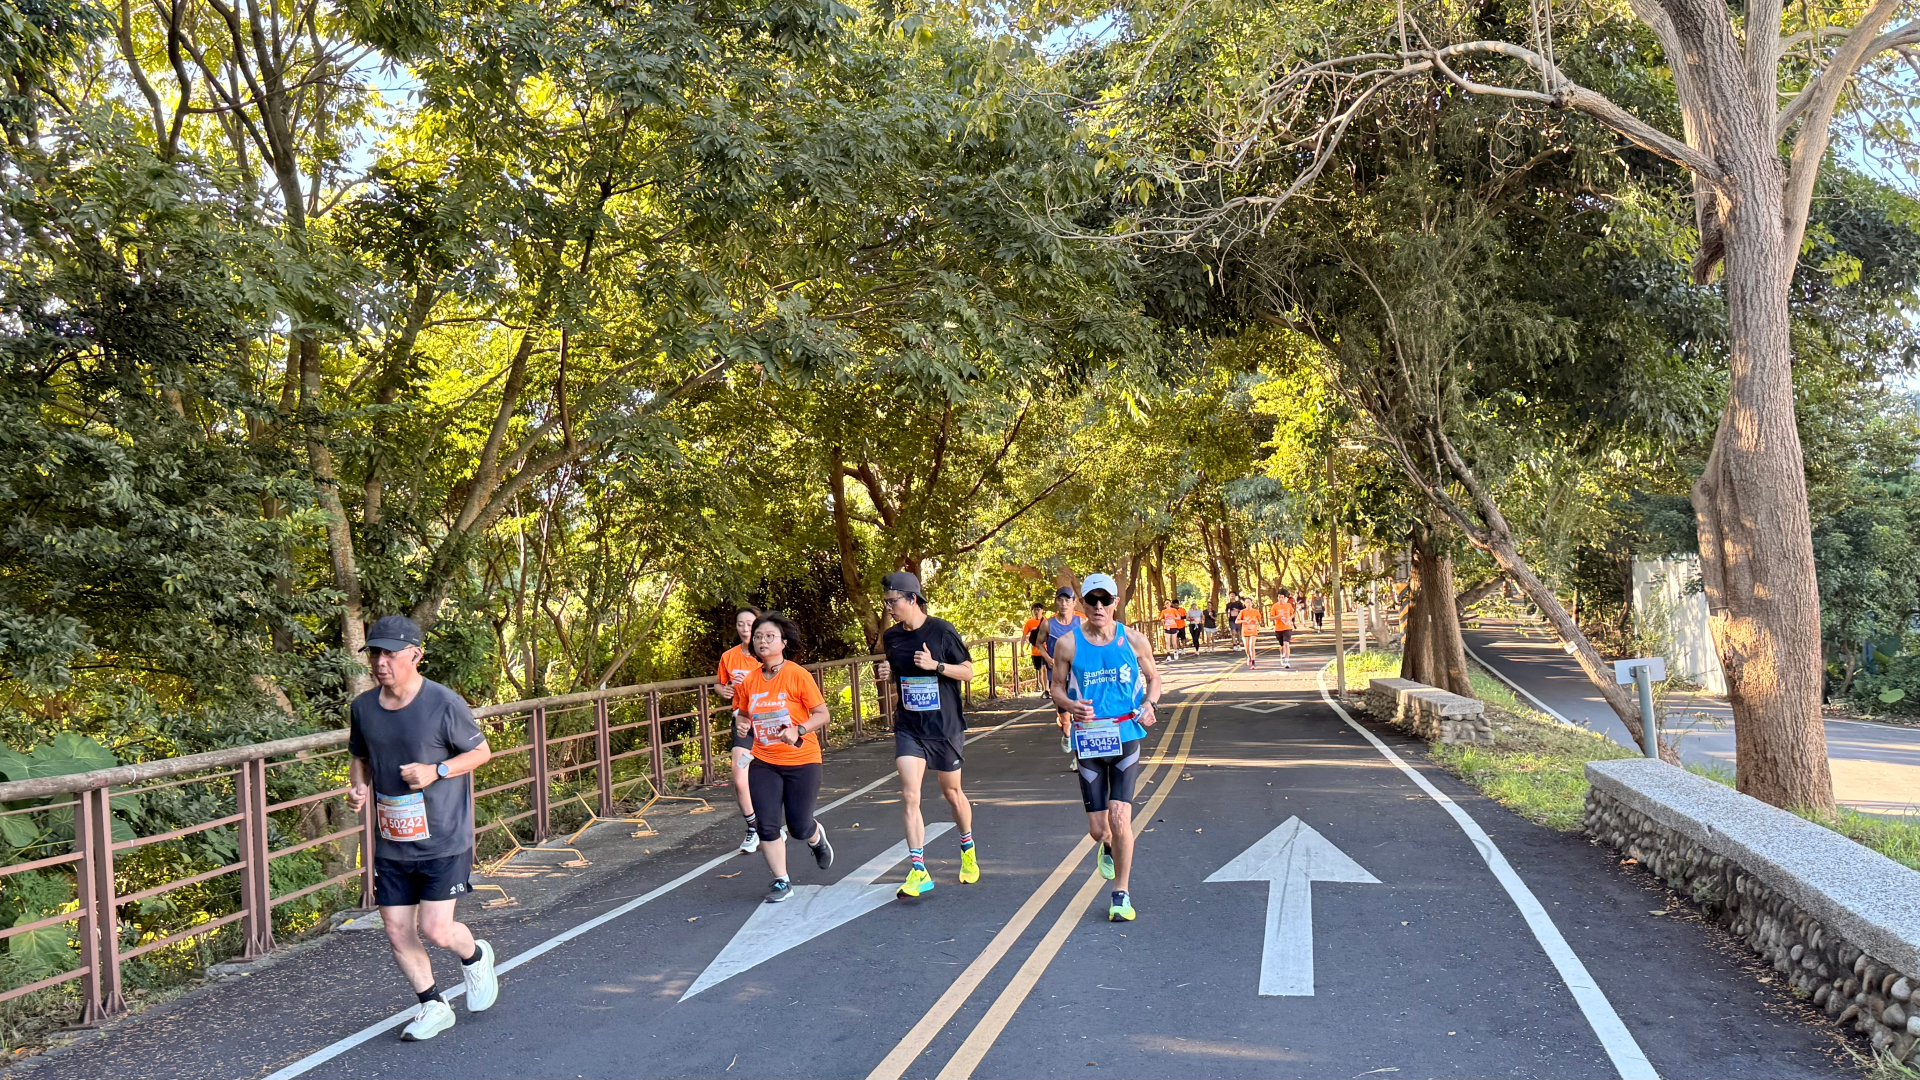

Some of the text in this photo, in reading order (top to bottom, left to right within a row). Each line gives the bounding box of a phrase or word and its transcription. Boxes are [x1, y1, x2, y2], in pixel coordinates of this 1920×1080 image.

[1084, 668, 1116, 679] Standard
[1083, 675, 1116, 686] Chartered
[912, 692, 936, 701] 30649
[1090, 738, 1118, 747] 30452
[390, 816, 423, 828] 50242
